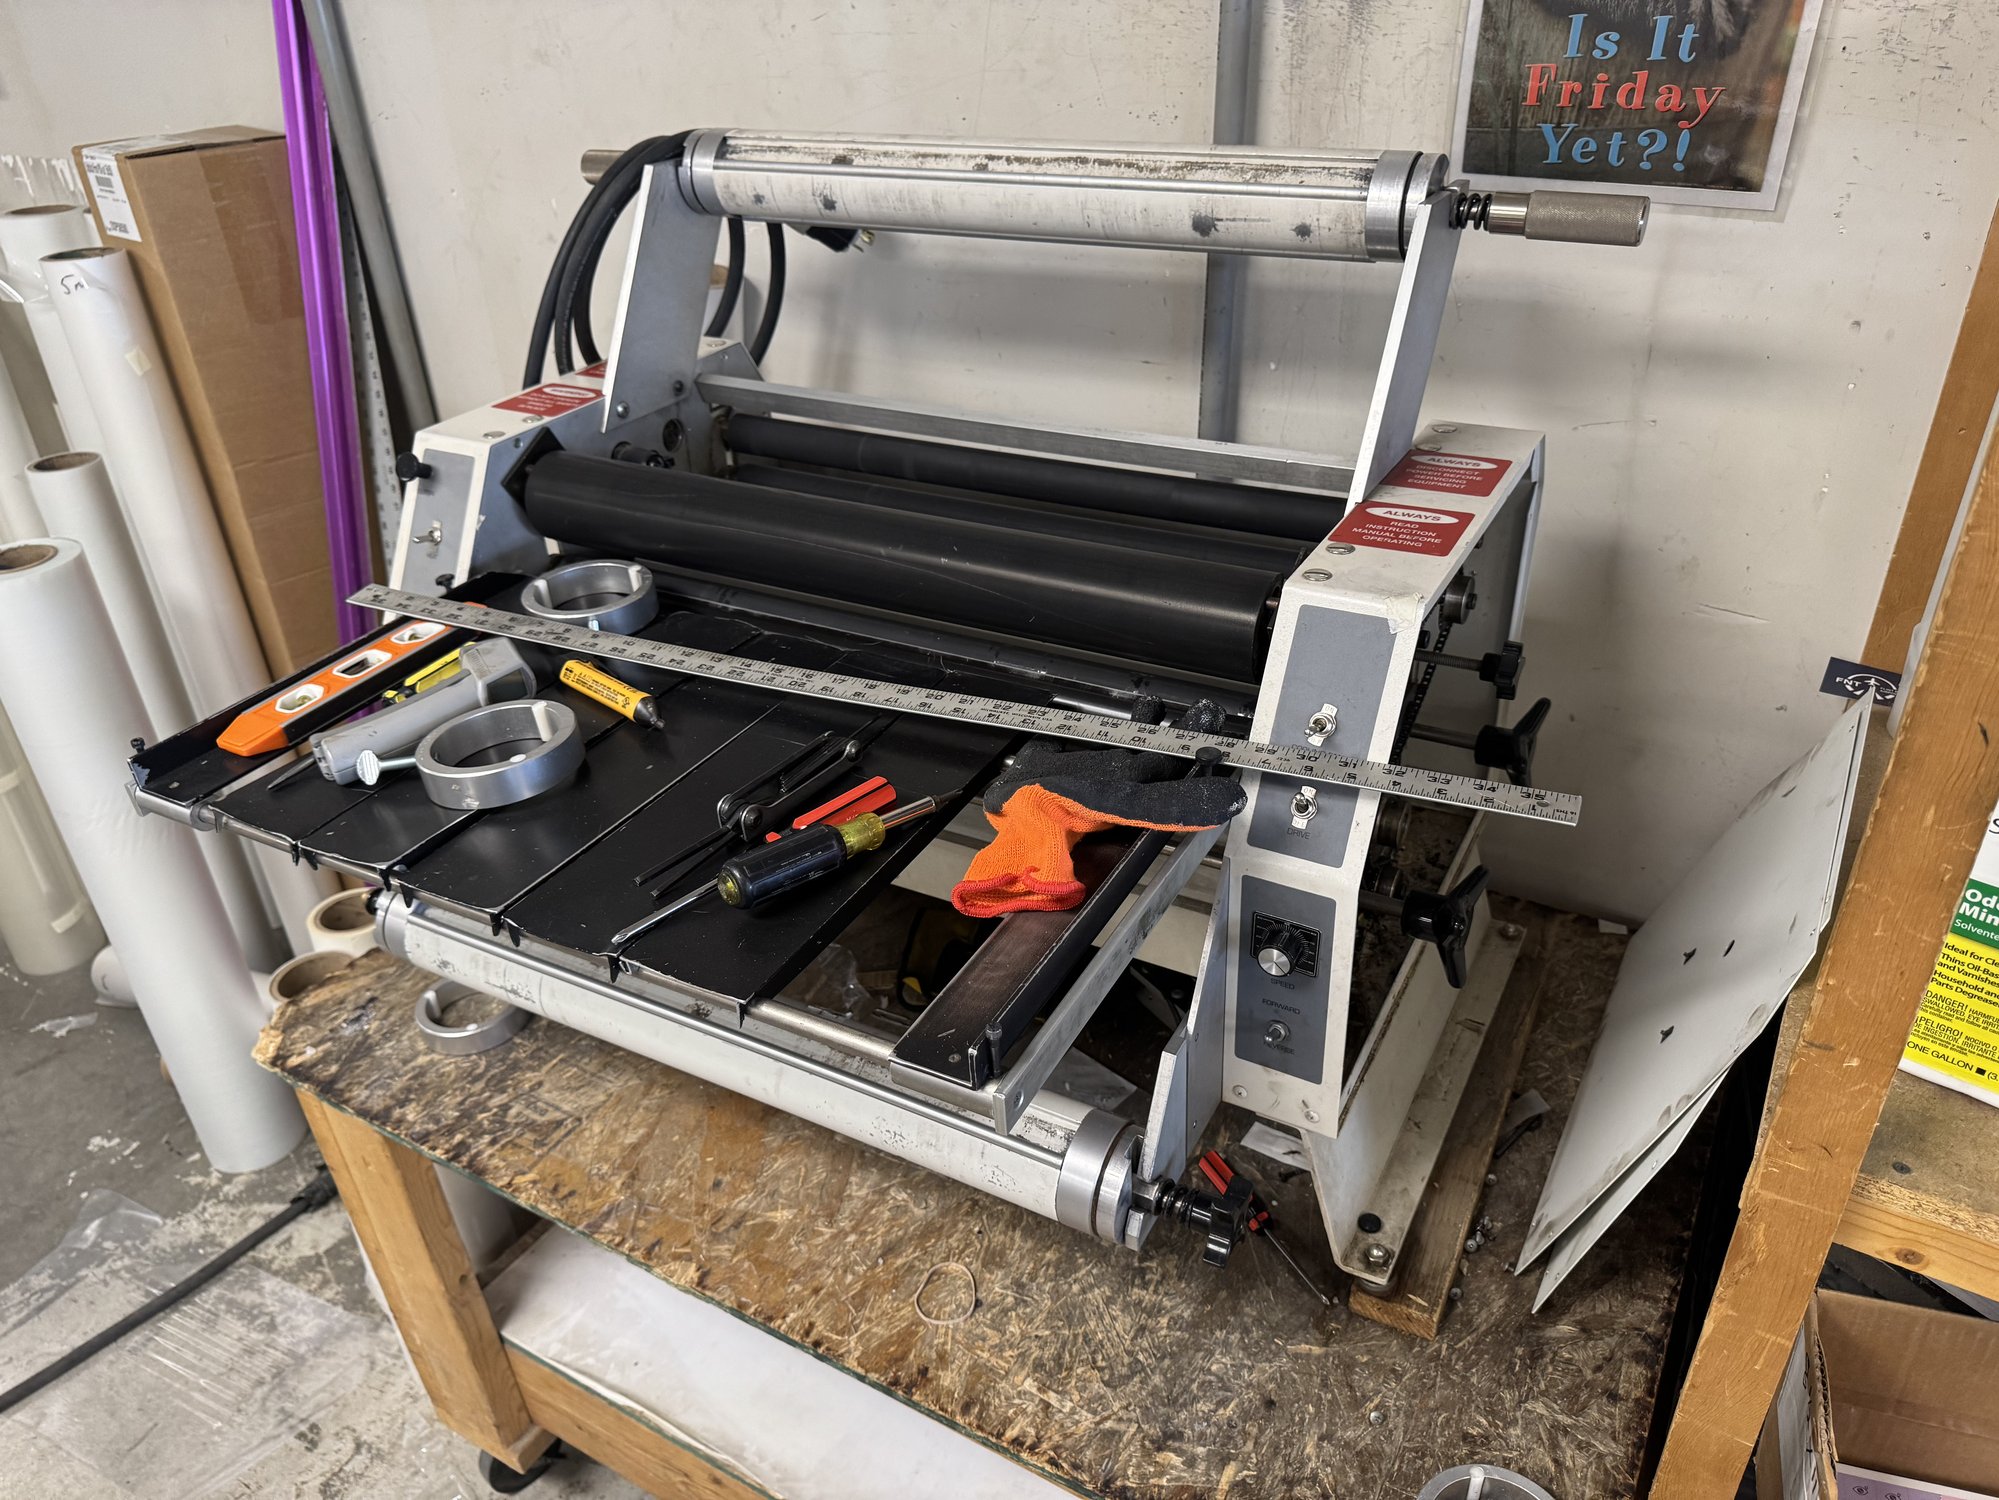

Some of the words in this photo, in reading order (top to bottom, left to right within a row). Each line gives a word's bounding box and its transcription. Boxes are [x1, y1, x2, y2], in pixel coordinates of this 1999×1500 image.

[1563, 13, 1621, 60] Is
[1646, 15, 1700, 63] It
[1521, 63, 1726, 129] Friday
[1537, 123, 1691, 172] Yet?!
[1427, 456, 1481, 467] ALWAYS
[1406, 468, 1446, 477] POWER
[1448, 473, 1483, 481] BEFORE
[1416, 465, 1480, 475] DISCONNECT
[1408, 479, 1467, 489] EQUIPMENT
[1414, 474, 1467, 484] SERVICING
[1383, 510, 1442, 522] ALWAYS
[1365, 524, 1437, 537] INSTRUCTION
[1390, 521, 1419, 529] READ
[1352, 528, 1396, 539] MANUAL
[1399, 534, 1443, 544] BEFORE
[1362, 535, 1424, 548] OPERATING
[609, 646, 627, 654] 26
[638, 652, 656, 660] 25
[668, 658, 686, 666] 24
[727, 669, 746, 678] 22
[761, 675, 777, 683] 21
[788, 680, 807, 688] 20
[820, 686, 834, 694] 19
[852, 692, 867, 700] 18
[885, 697, 900, 705] 17
[918, 701, 933, 710] 16
[952, 707, 967, 716] 15
[987, 712, 1001, 720] 14
[1021, 718, 1036, 726] 13
[681, 650, 695, 658] 12
[740, 661, 753, 669] 14
[770, 666, 784, 674] 15
[801, 672, 815, 680] 16
[832, 677, 847, 685] 17
[896, 688, 911, 696] 19
[925, 693, 945, 701] 20
[958, 697, 974, 705] 21
[992, 702, 1012, 711] 22
[1027, 708, 1049, 717] 23
[1063, 714, 1082, 723] 24
[1100, 720, 1119, 729] 25
[1137, 727, 1157, 735] 26
[1175, 734, 1197, 742] 27
[1215, 741, 1237, 749] 28
[1254, 746, 1278, 755] 29
[1296, 753, 1318, 762] 30
[1338, 759, 1357, 769] 31
[1382, 769, 1406, 777] 32
[1428, 776, 1451, 784] 33
[1473, 784, 1497, 793] 34
[1521, 792, 1546, 801] 35
[1097, 729, 1109, 738] 11
[1131, 736, 1147, 745] 10
[1286, 827, 1311, 840] DRIVE
[1945, 943, 1969, 956] Ideal
[1970, 952, 1984, 961] for
[1942, 952, 1965, 967] Thins
[1967, 963, 1999, 979] Oil-Bas
[1938, 961, 1957, 972] and
[1957, 967, 1999, 988] Varnishes
[1270, 978, 1295, 991] SPEED
[1931, 977, 1954, 991] Parts
[1934, 970, 1985, 994] Household
[1262, 998, 1301, 1015] FORWARD
[1926, 990, 1969, 1012] DANGER!
[1923, 997, 1966, 1018] SWALLOWED.
[1968, 1014, 1980, 1023] EYE
[1982, 1020, 1999, 1033] IRRIT
[1915, 1016, 1964, 1039] ¡PELIGRO!
[1965, 1035, 1991, 1049] NOCIVO
[1923, 1025, 1960, 1045] INGESTION.
[1962, 1040, 1997, 1058] IRRITANTE
[1907, 1040, 1930, 1055] ONE
[1931, 1050, 1974, 1072] GALLON
